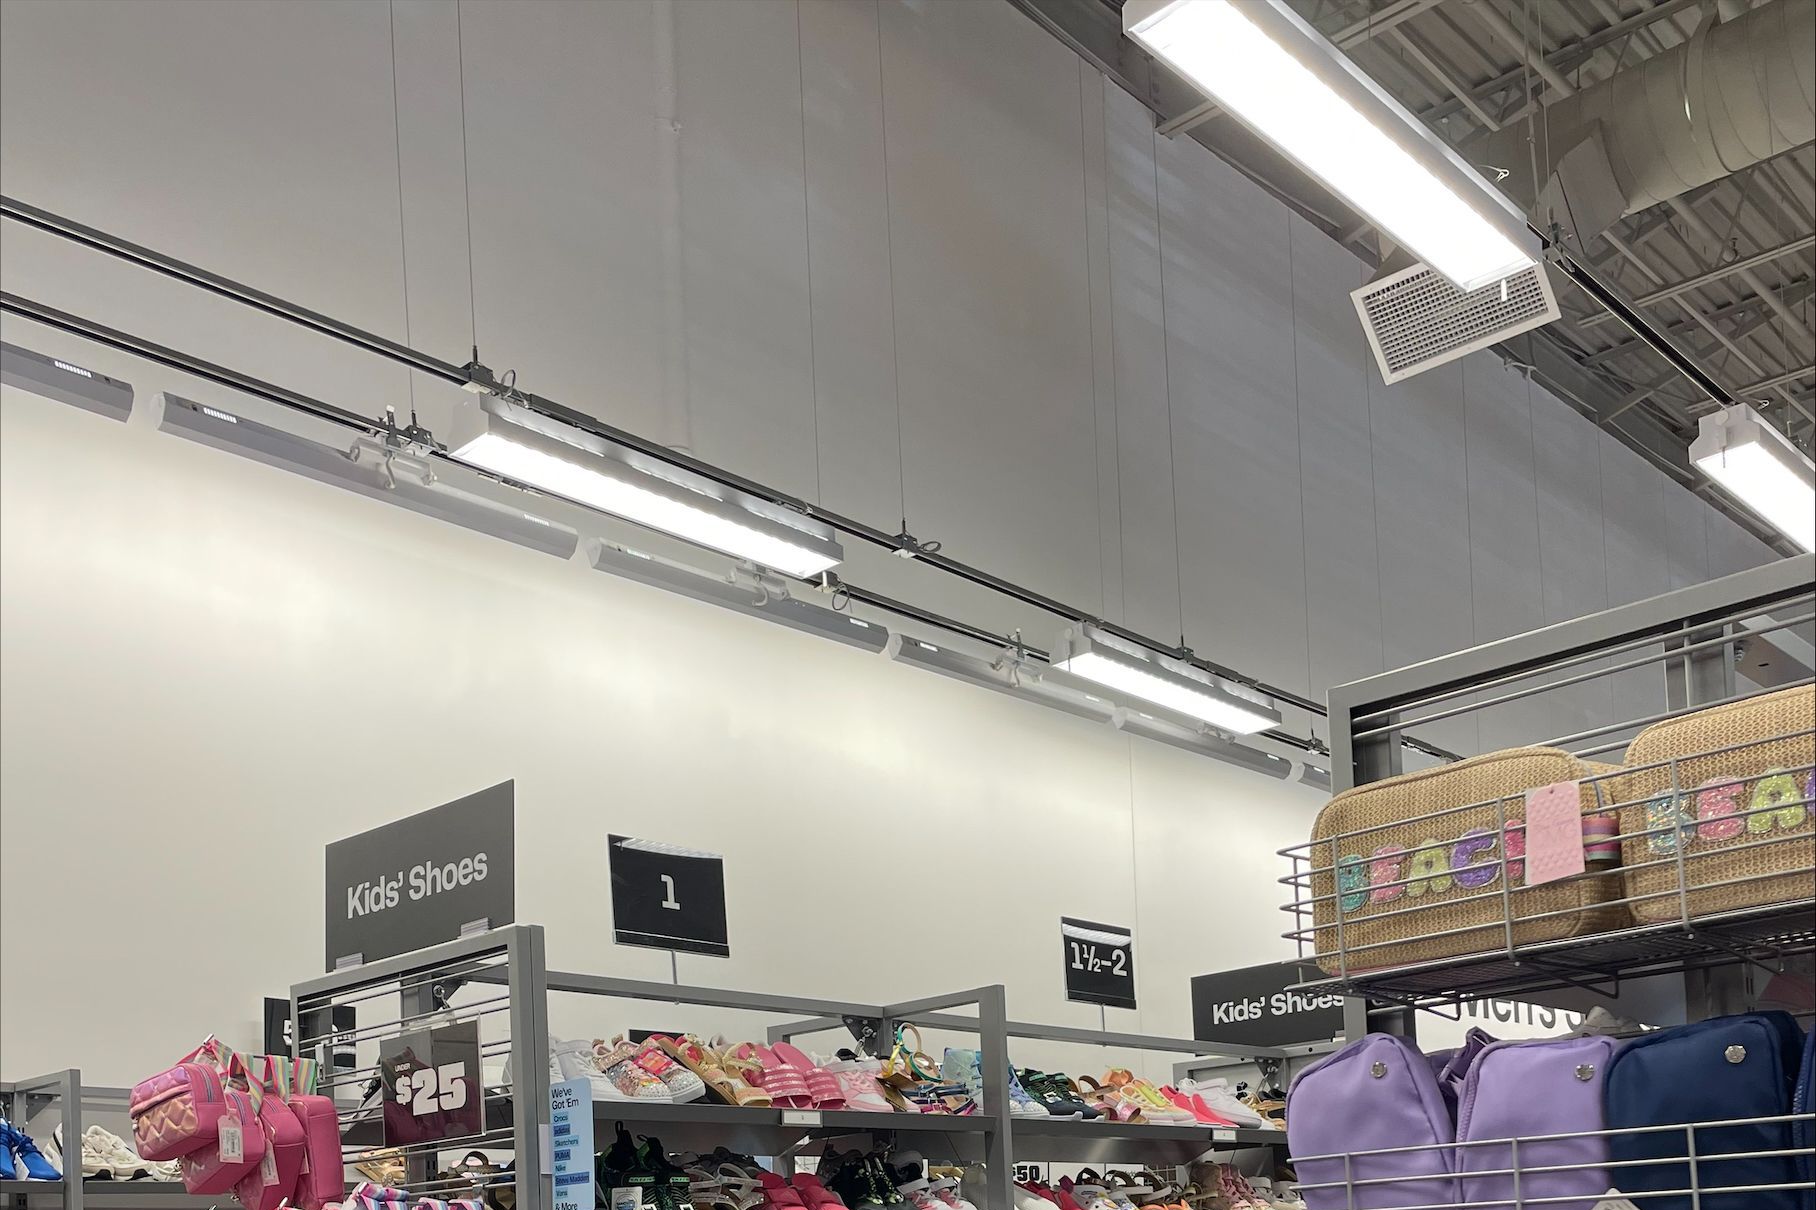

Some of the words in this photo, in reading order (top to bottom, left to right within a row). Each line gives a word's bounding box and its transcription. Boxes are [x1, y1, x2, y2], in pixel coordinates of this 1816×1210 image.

[1645, 765, 1815, 856] BEA
[347, 871, 403, 919] Kids'
[408, 852, 488, 900] Shoes
[660, 874, 680, 910] 1
[1212, 996, 1266, 1025] Kids'
[394, 1062, 411, 1072] UNDER
[395, 1061, 467, 1116] $25
[551, 1100, 565, 1110] Got
